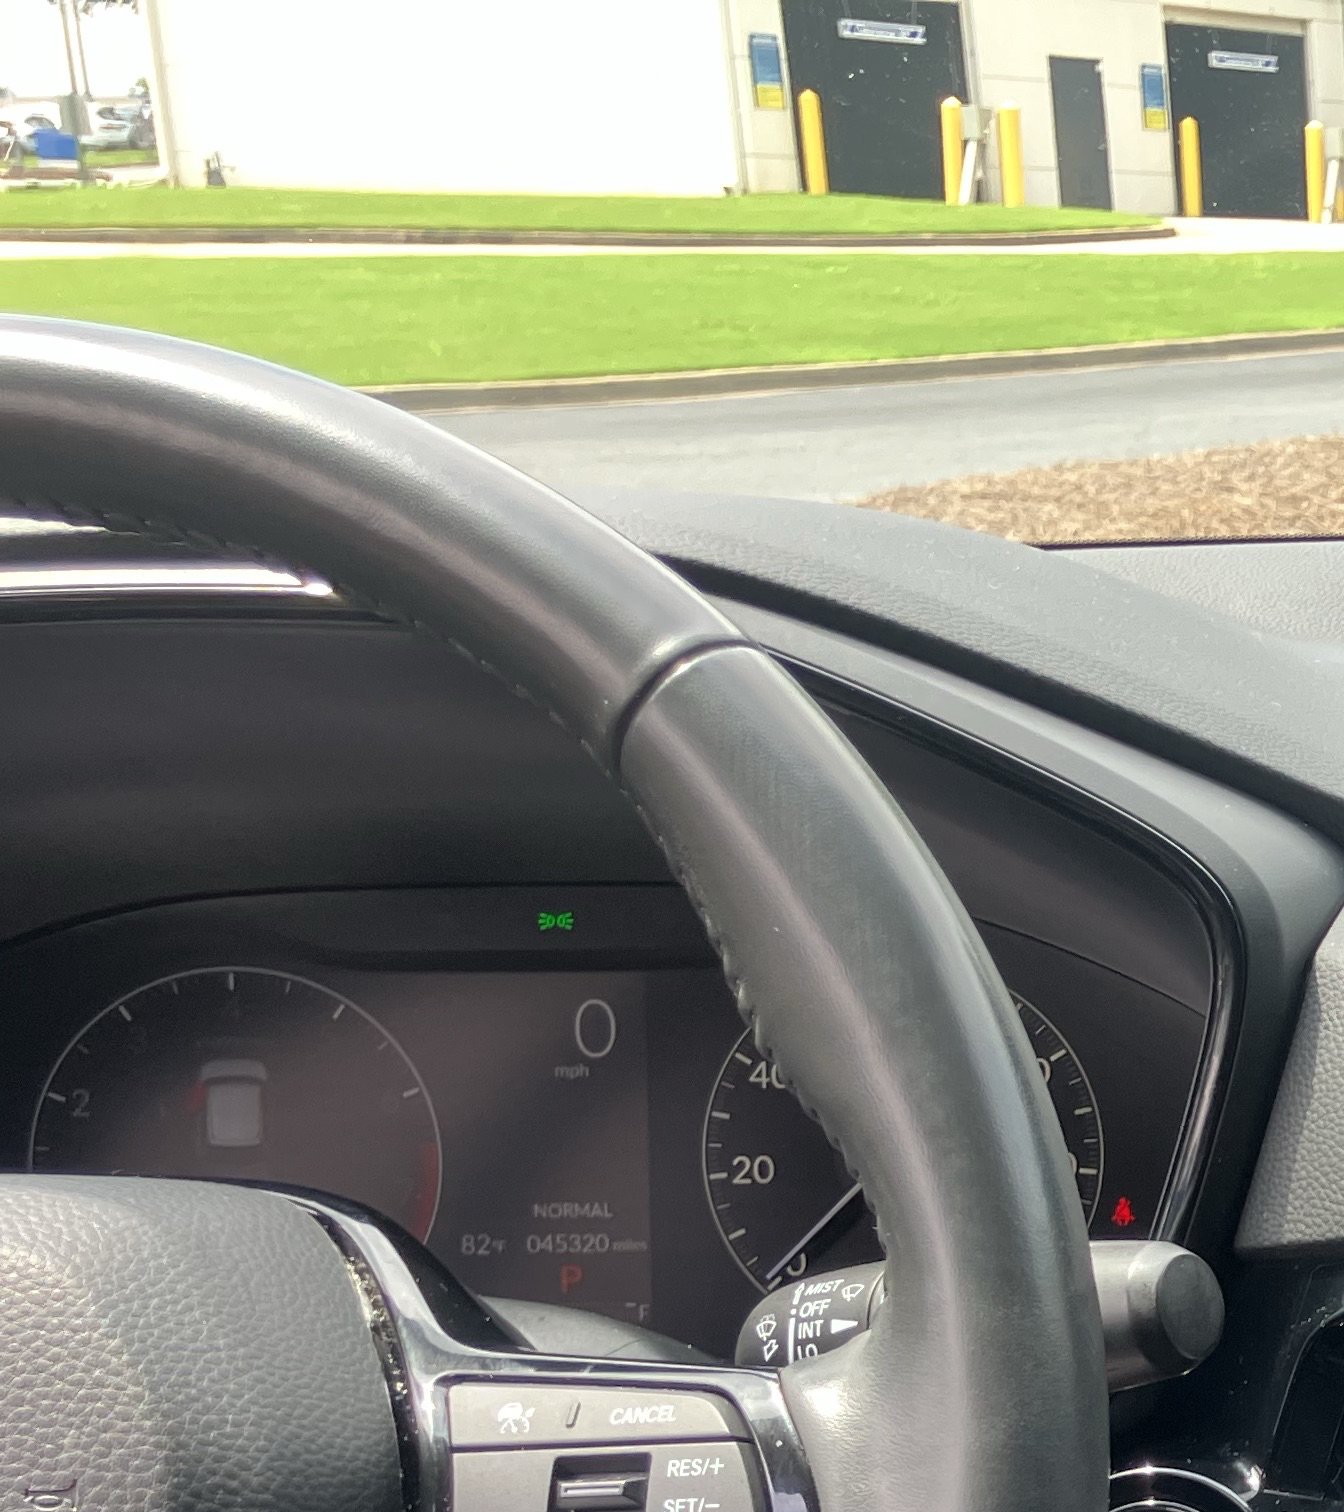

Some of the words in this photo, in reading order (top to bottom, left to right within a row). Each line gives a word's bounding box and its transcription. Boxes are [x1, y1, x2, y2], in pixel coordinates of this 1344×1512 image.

[574, 998, 616, 1058] 0
[553, 1063, 590, 1081] mph
[732, 1157, 776, 1185] 20
[532, 1201, 614, 1219] NORMAL
[804, 1279, 844, 1296] MIST
[800, 1299, 831, 1317] OFF
[798, 1320, 824, 1339] INT
[610, 1406, 677, 1426] CANCEL
